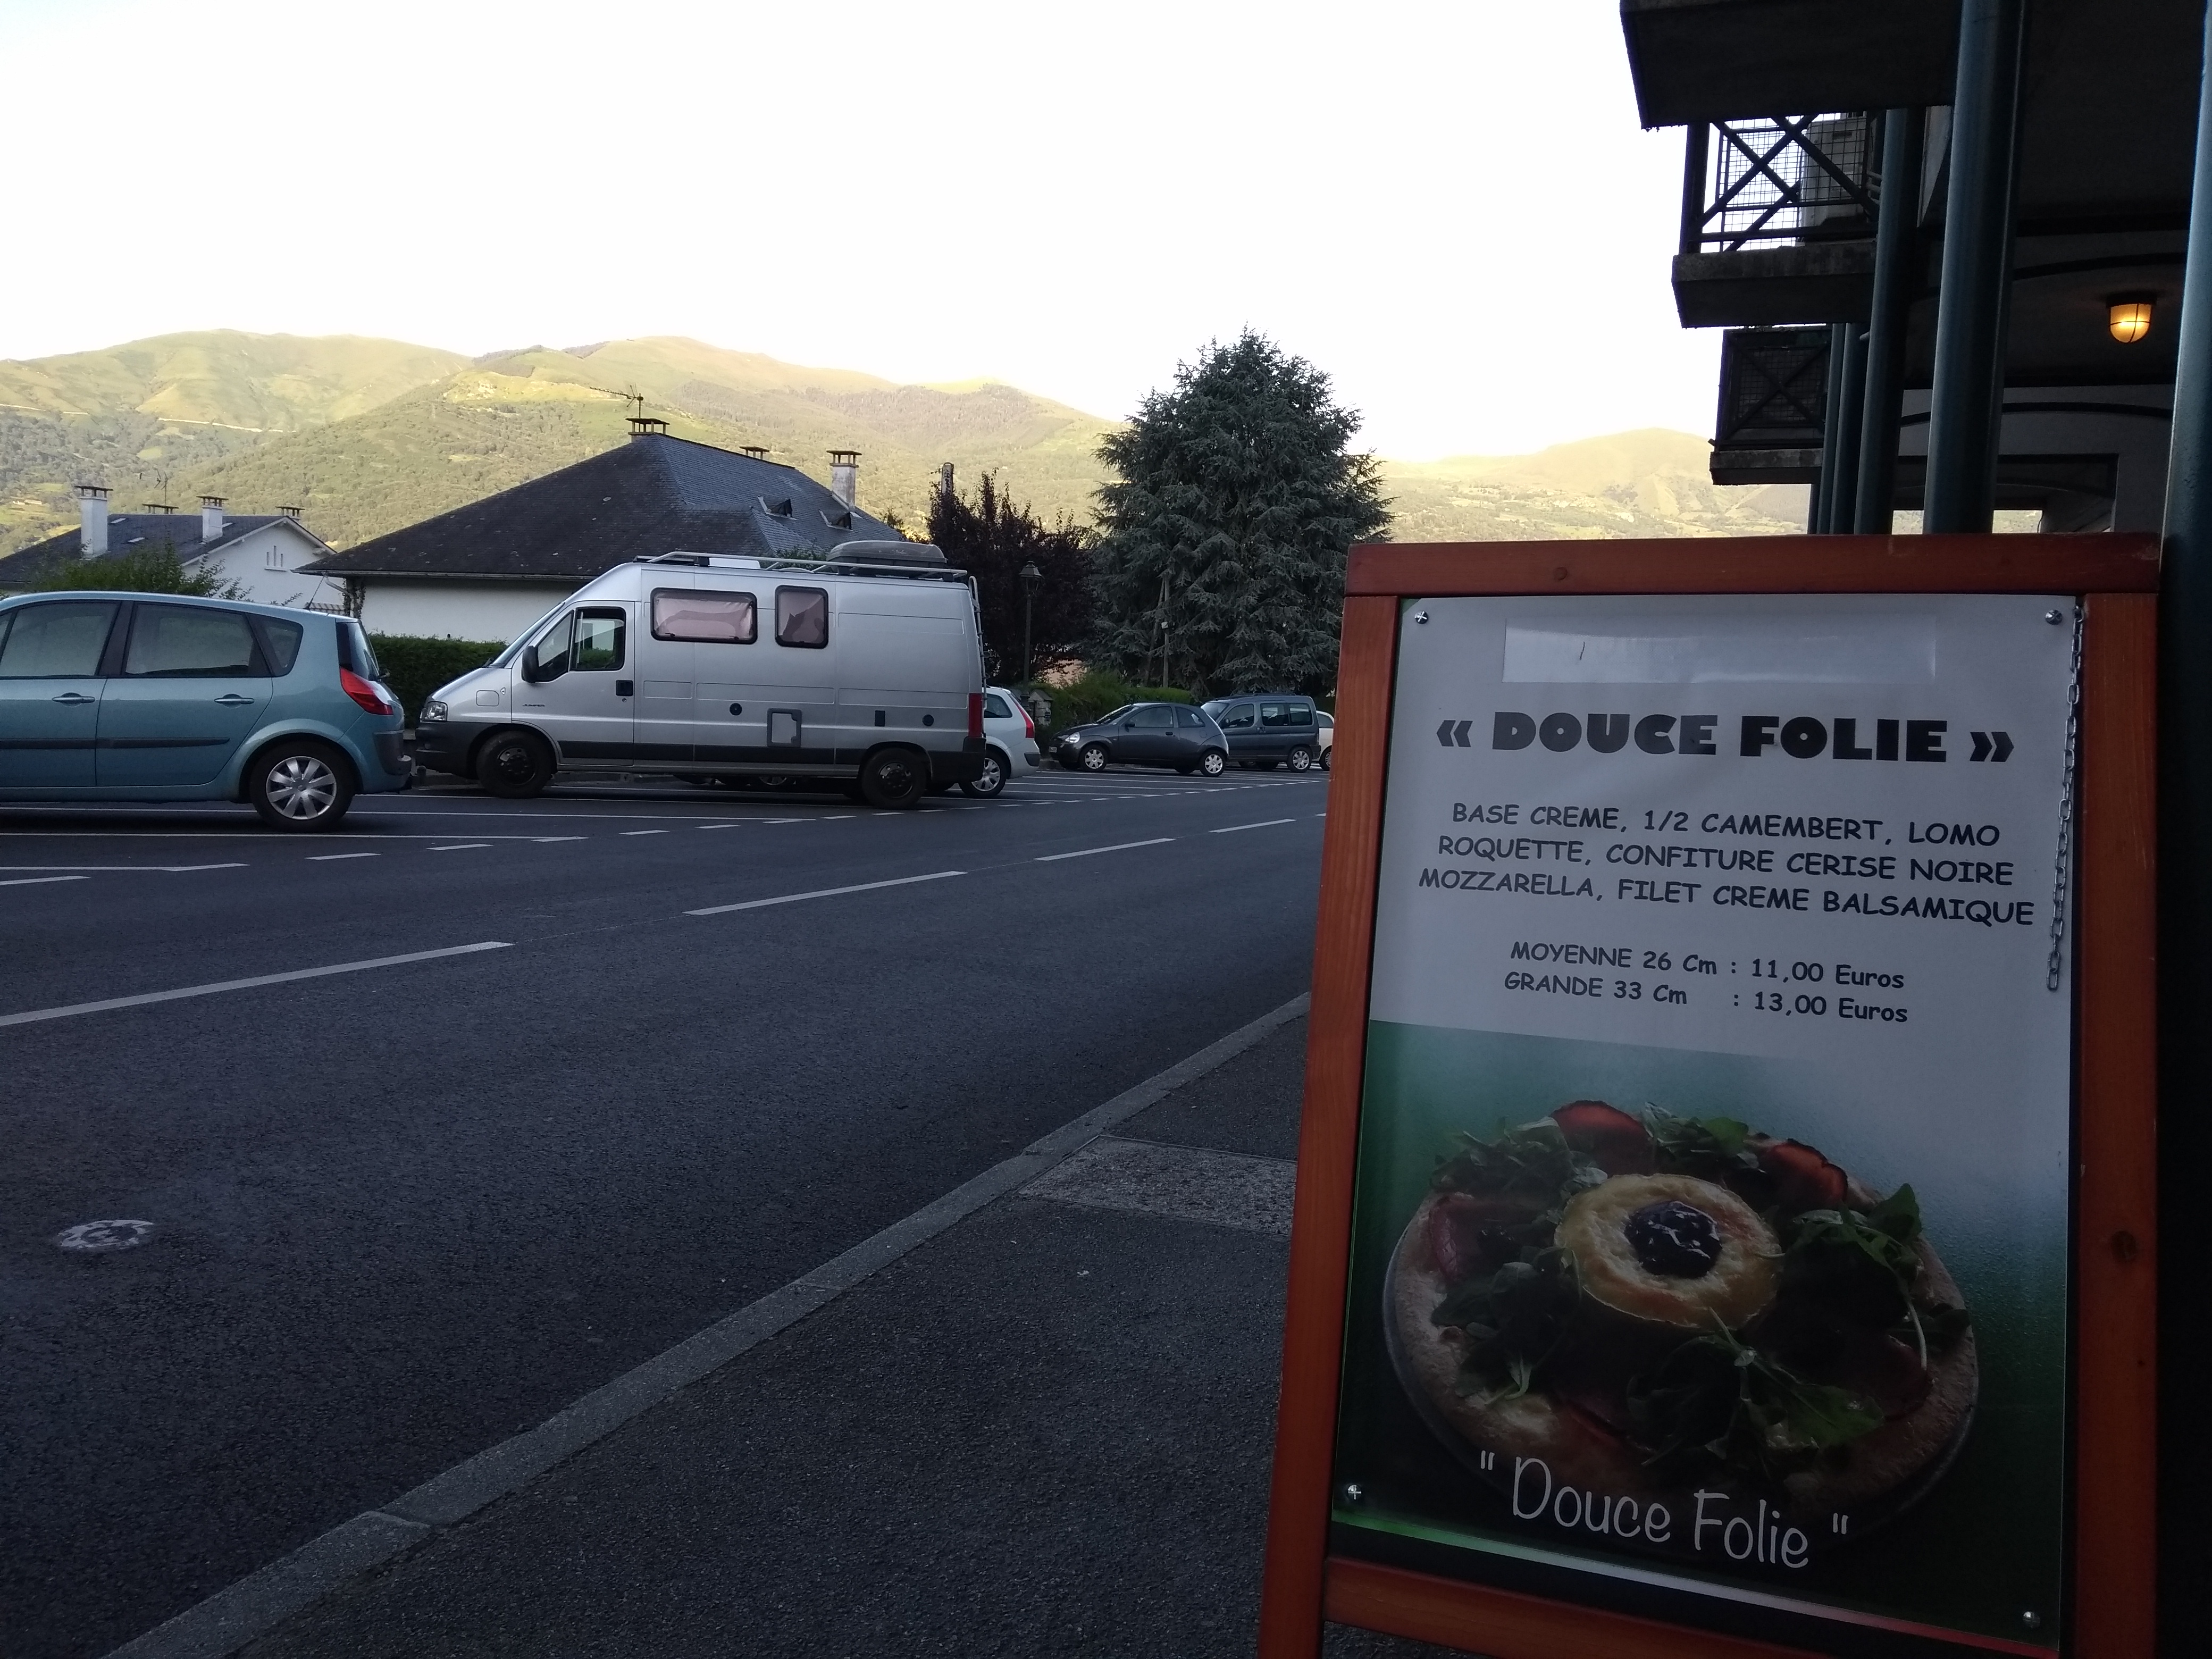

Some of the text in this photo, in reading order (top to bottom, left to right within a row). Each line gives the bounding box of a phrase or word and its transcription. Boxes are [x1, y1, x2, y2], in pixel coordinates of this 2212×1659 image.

[1492, 711, 1718, 756] DOUCE
[1739, 715, 1948, 763] FOLIE
[1452, 802, 2000, 847] BASE CREME, 1/2 CAMEMBERT, LOMO
[1438, 835, 2014, 887] ROQUETTE, CONFITURE CERISE NOIRE
[1419, 868, 2035, 927] MOZZARELLA, FILET CREME BALSAMIQUE
[1510, 941, 1633, 968] MOYENNE
[1643, 950, 1672, 971] 26
[1682, 954, 1717, 975] Cm
[1752, 958, 1824, 983] 11,00
[1835, 963, 1905, 989] Euros
[1504, 971, 1604, 998] GRANDE
[1613, 980, 1642, 1000] 33
[1653, 984, 1687, 1005] Cm
[1754, 991, 1827, 1017] 13,00
[1838, 997, 1908, 1023] Euros
[1512, 1456, 1671, 1543] Douce
[1693, 1489, 1809, 1569] Folie
